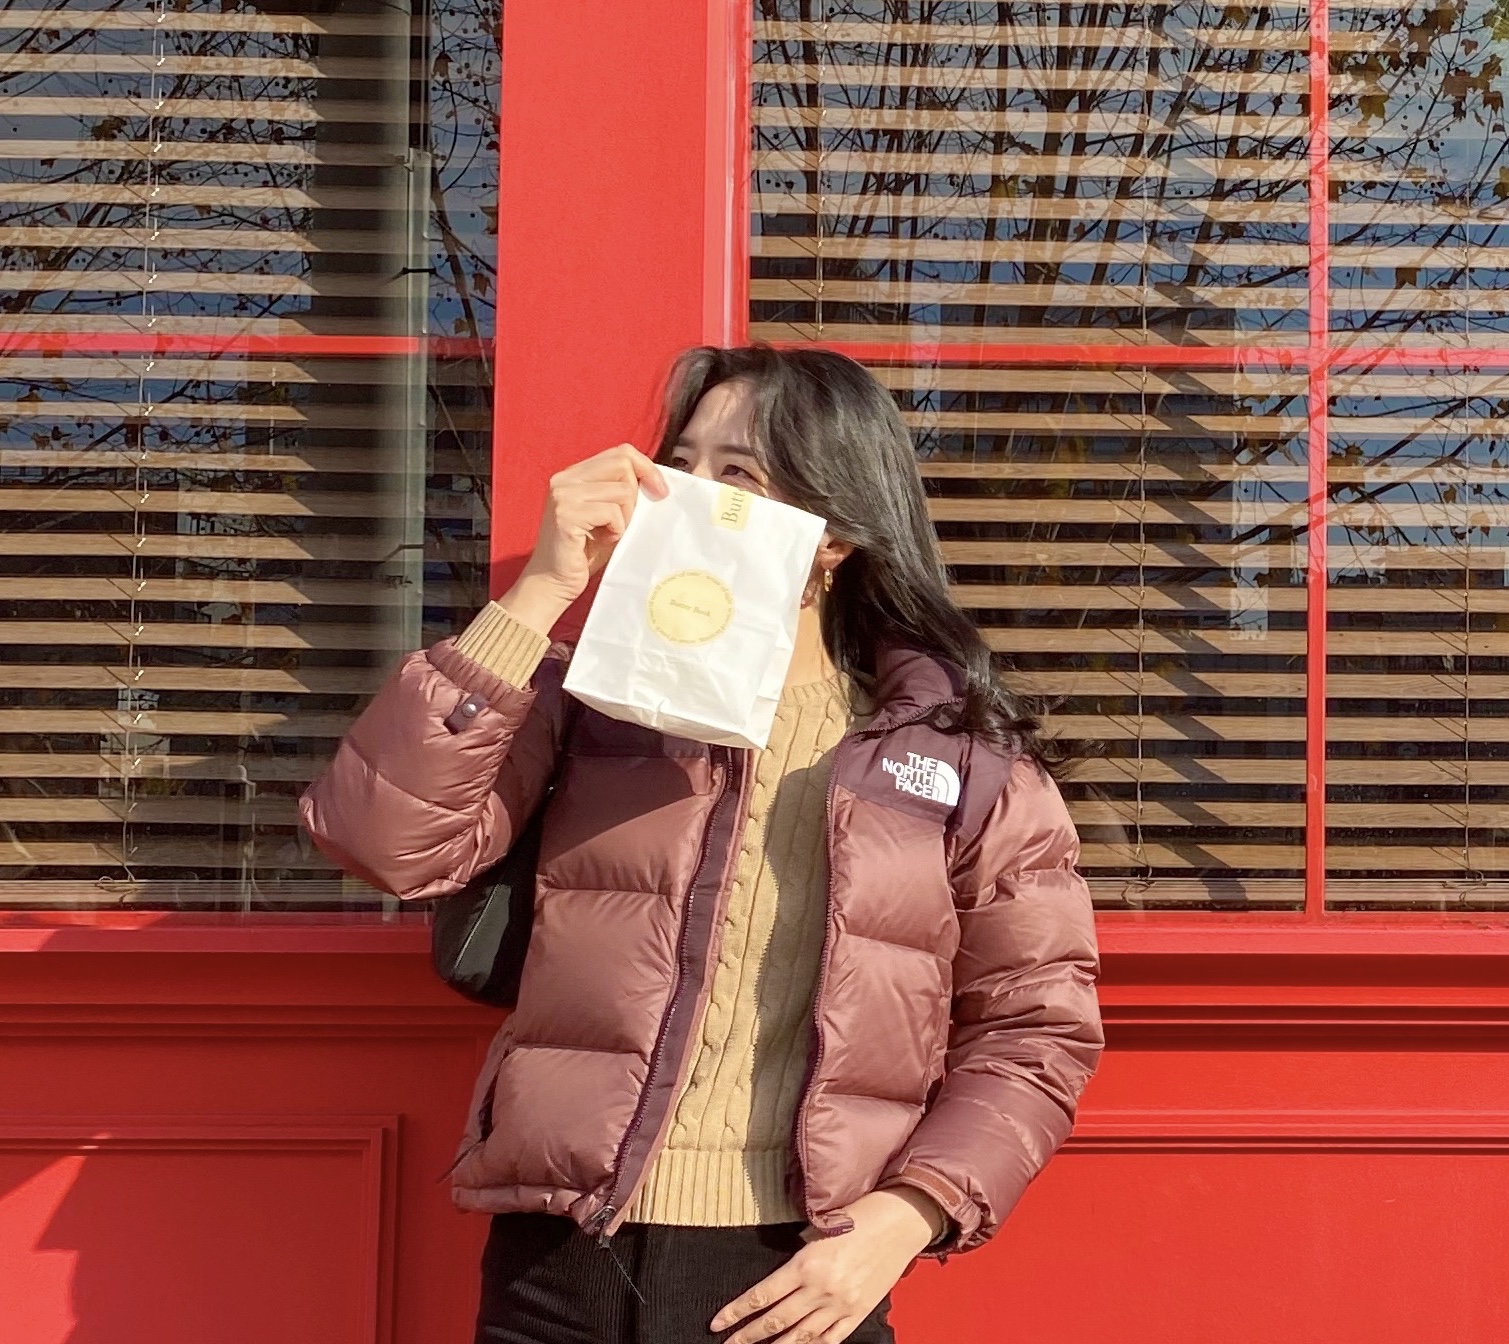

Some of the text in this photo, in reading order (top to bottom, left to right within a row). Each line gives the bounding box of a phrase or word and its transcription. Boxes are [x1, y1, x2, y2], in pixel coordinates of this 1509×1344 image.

[720, 489, 746, 524] Butt
[882, 757, 935, 786] NORTH
[906, 751, 938, 773] THE
[895, 776, 933, 799] FACE
